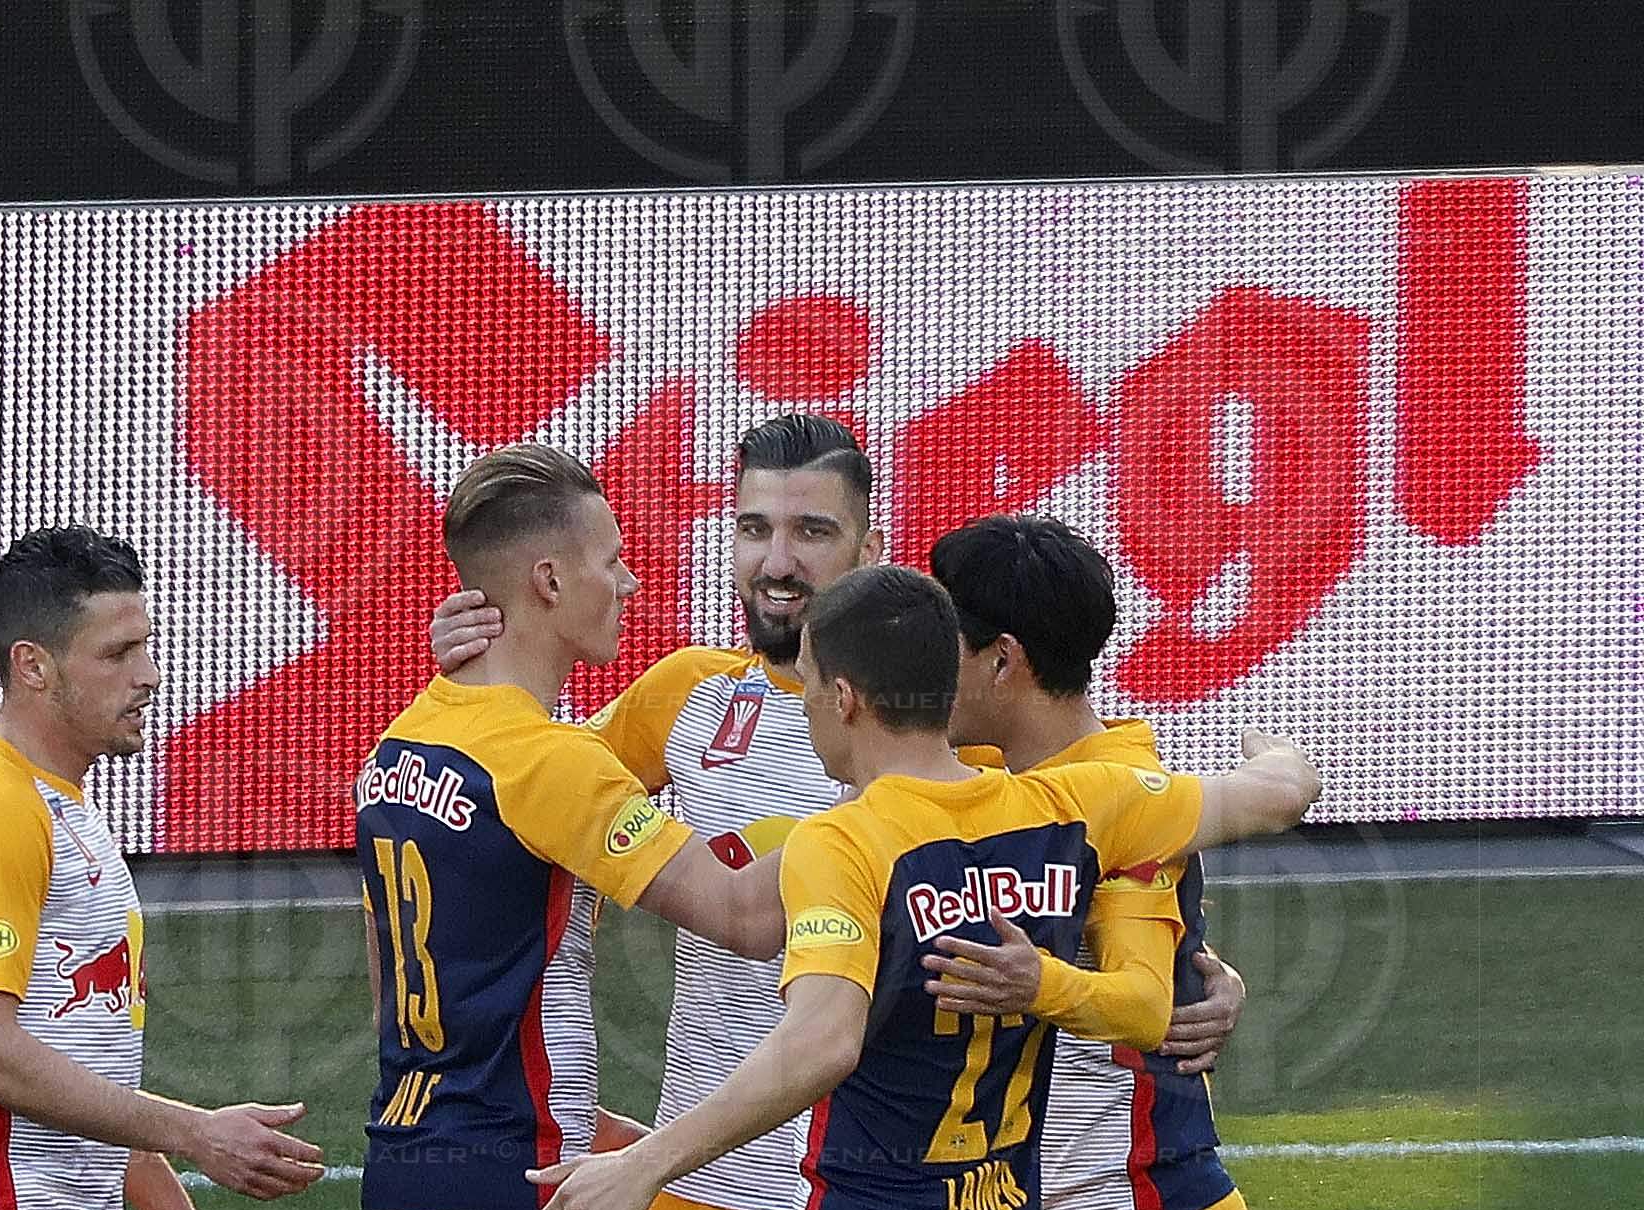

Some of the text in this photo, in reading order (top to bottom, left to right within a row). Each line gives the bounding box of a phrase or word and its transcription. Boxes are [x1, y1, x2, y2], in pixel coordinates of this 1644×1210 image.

[795, 918, 853, 938] RAUCH
[908, 871, 981, 938] Red
[373, 838, 445, 1053] 13
